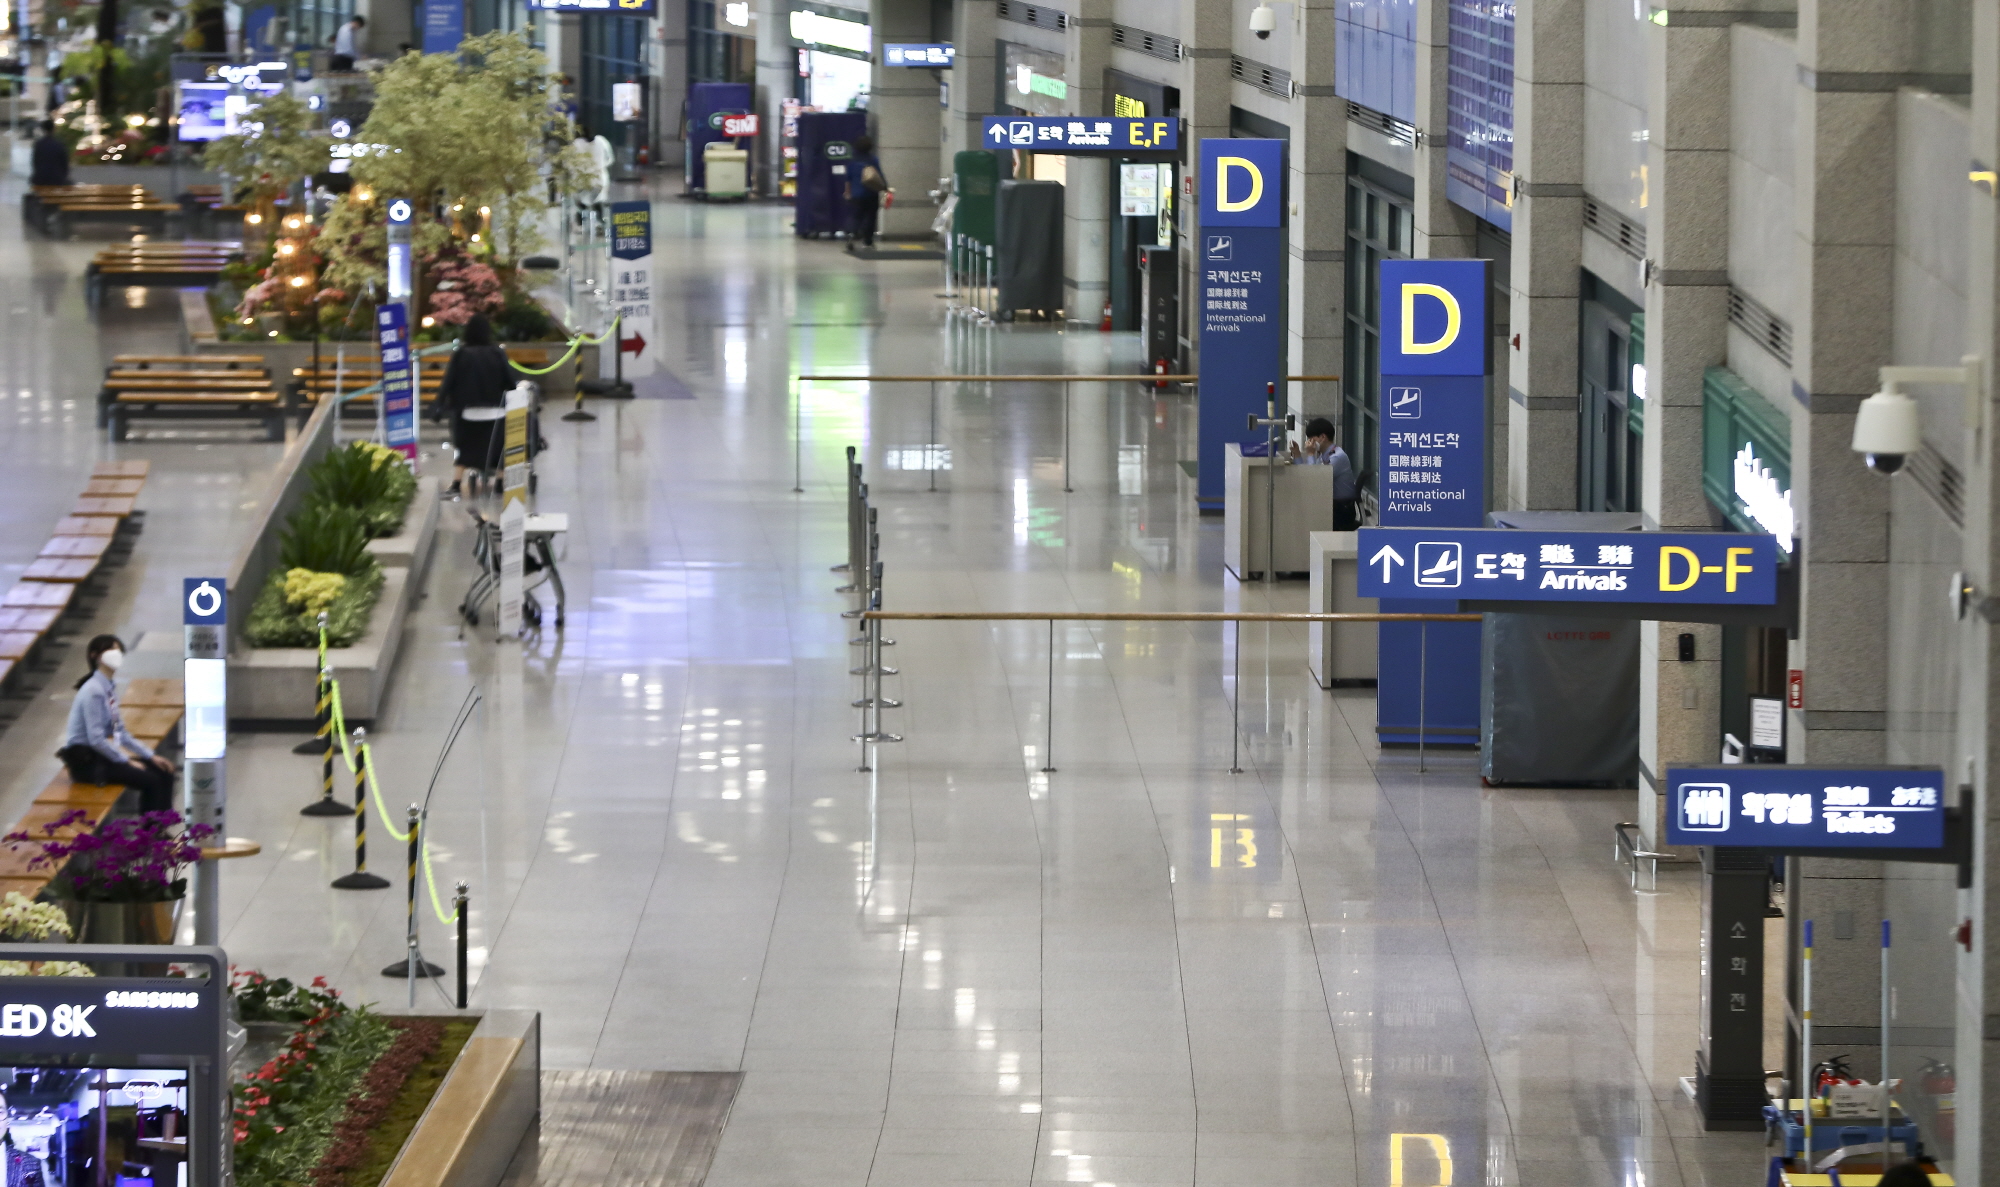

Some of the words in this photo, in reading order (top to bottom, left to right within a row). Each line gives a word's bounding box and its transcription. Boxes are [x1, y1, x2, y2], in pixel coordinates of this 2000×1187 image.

[725, 115, 757, 134] SIM
[1038, 126, 1063, 141] 도착
[1130, 122, 1168, 148] E,F
[827, 145, 846, 155] CU
[1217, 157, 1264, 212] D
[1206, 270, 1262, 283] 국제선도착
[1206, 314, 1266, 323] International
[1206, 323, 1240, 332] Arrivals
[1401, 283, 1461, 354] D
[1389, 432, 1460, 448] 국제선도착
[1389, 455, 1443, 467] 国際線到着
[1388, 471, 1442, 484] 国际线到达
[1388, 488, 1465, 500] International
[1388, 501, 1432, 512] Arrivals
[1474, 552, 1527, 581] 도착
[1659, 545, 1754, 593] D-F
[1539, 570, 1628, 591] Arrivals
[1741, 791, 1812, 825] 화장실
[1822, 811, 1896, 834] Toilets
[1730, 921, 1747, 1011] 소화전
[105, 991, 199, 1009] SAMSUNG
[51, 1003, 98, 1038] 8K
